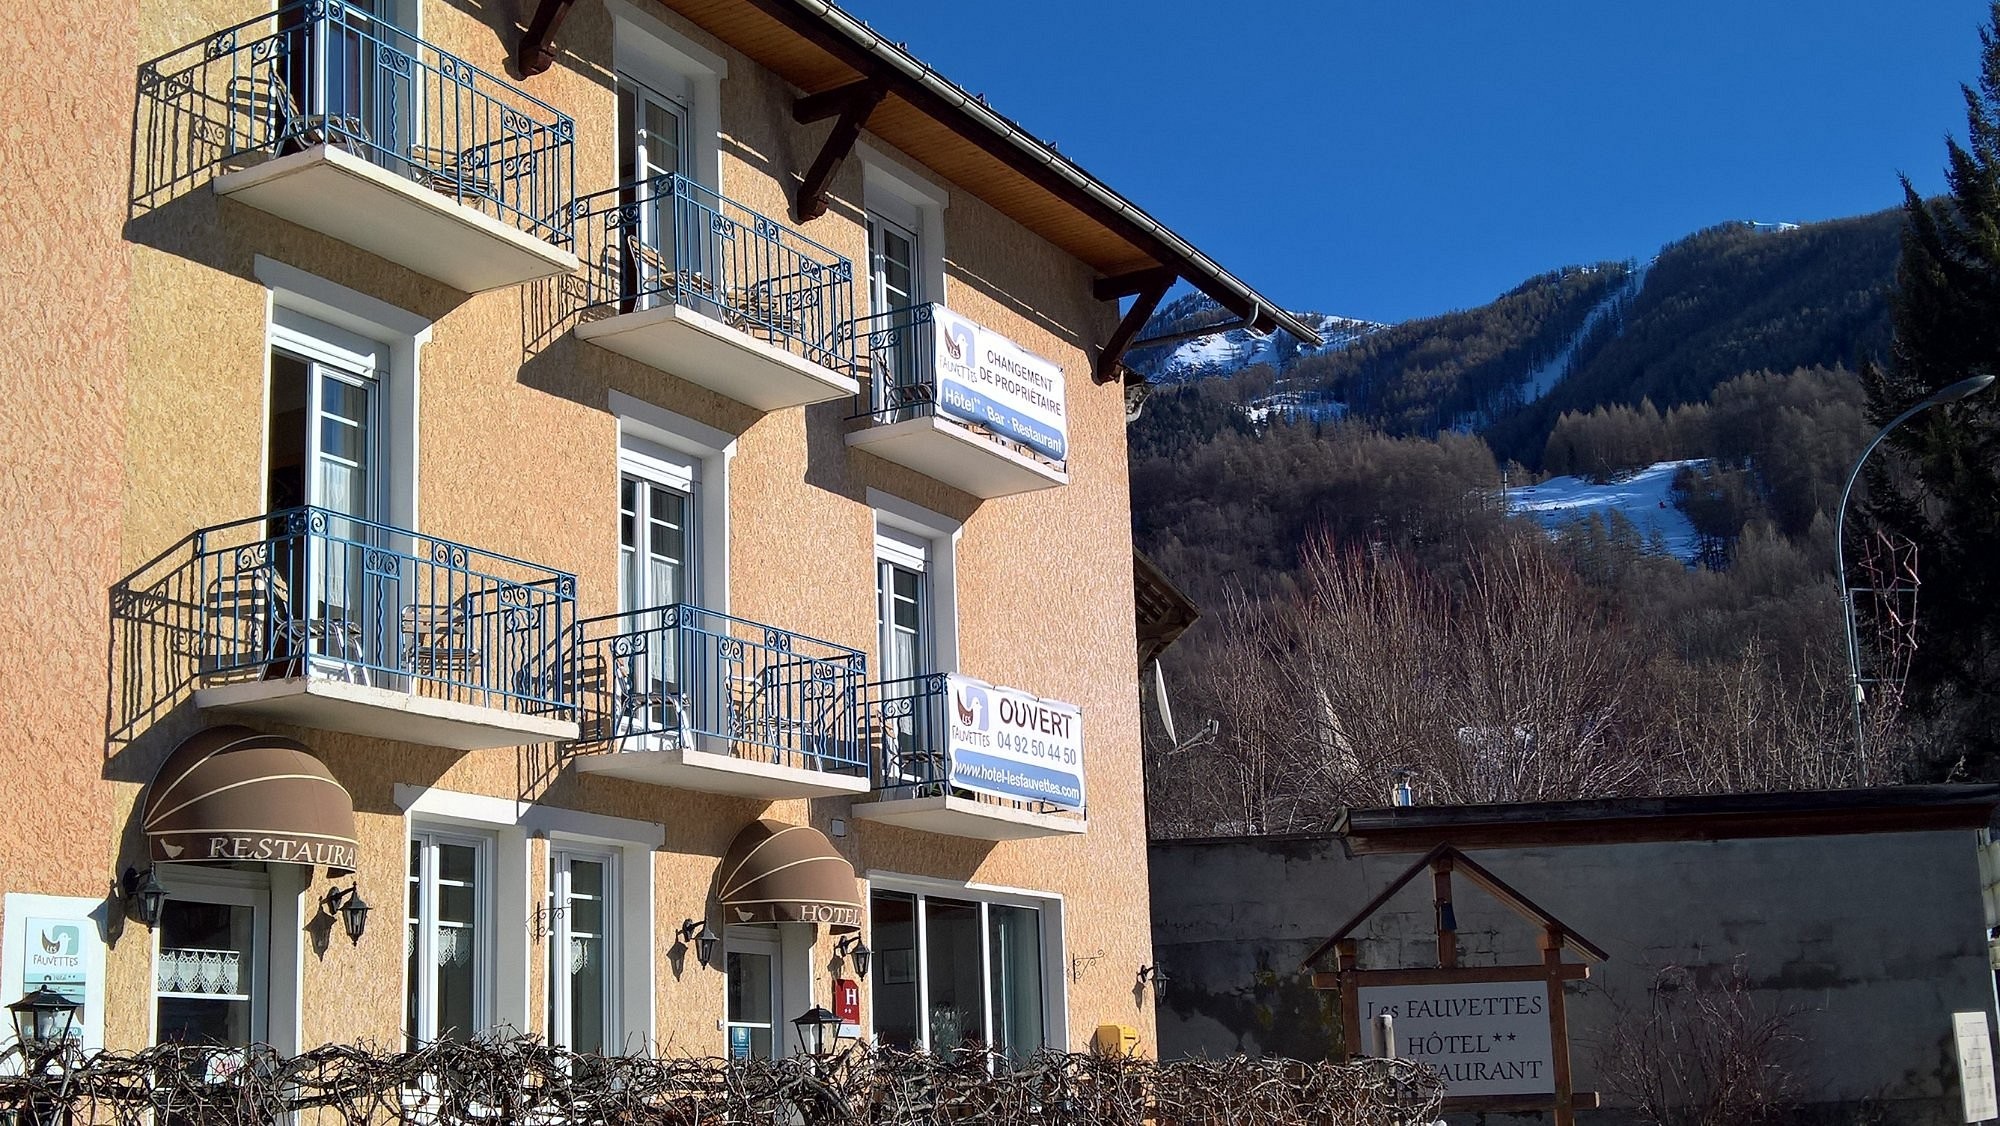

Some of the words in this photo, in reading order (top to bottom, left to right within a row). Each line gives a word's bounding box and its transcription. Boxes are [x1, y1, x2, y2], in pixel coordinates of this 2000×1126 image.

[939, 354, 978, 383] FAUVETTES
[987, 349, 1053, 393] CHANGEMENT
[980, 366, 993, 386] DE
[995, 375, 1062, 416] PROPRIÉTAIRE
[945, 387, 975, 414] Hôtel
[987, 405, 1005, 426] Bar
[1011, 417, 1063, 454] Restaurant
[1000, 698, 1073, 740] OUVERT
[952, 725, 991, 749] FAUVETTES
[997, 731, 1012, 751] 04
[1014, 735, 1029, 755] 92
[1031, 740, 1045, 759] 50
[1047, 744, 1061, 762] 44
[1064, 748, 1077, 766] 50
[955, 762, 1080, 800] www.hotel-lesfauvettes.com
[208, 837, 358, 868] RESTAURA
[33, 954, 79, 967] FAUVETTES
[845, 988, 858, 1006] H
[1367, 1001, 1399, 1020] Les
[1407, 995, 1543, 1018] FAUVETTES
[1407, 1031, 1491, 1056] HÔTEL
